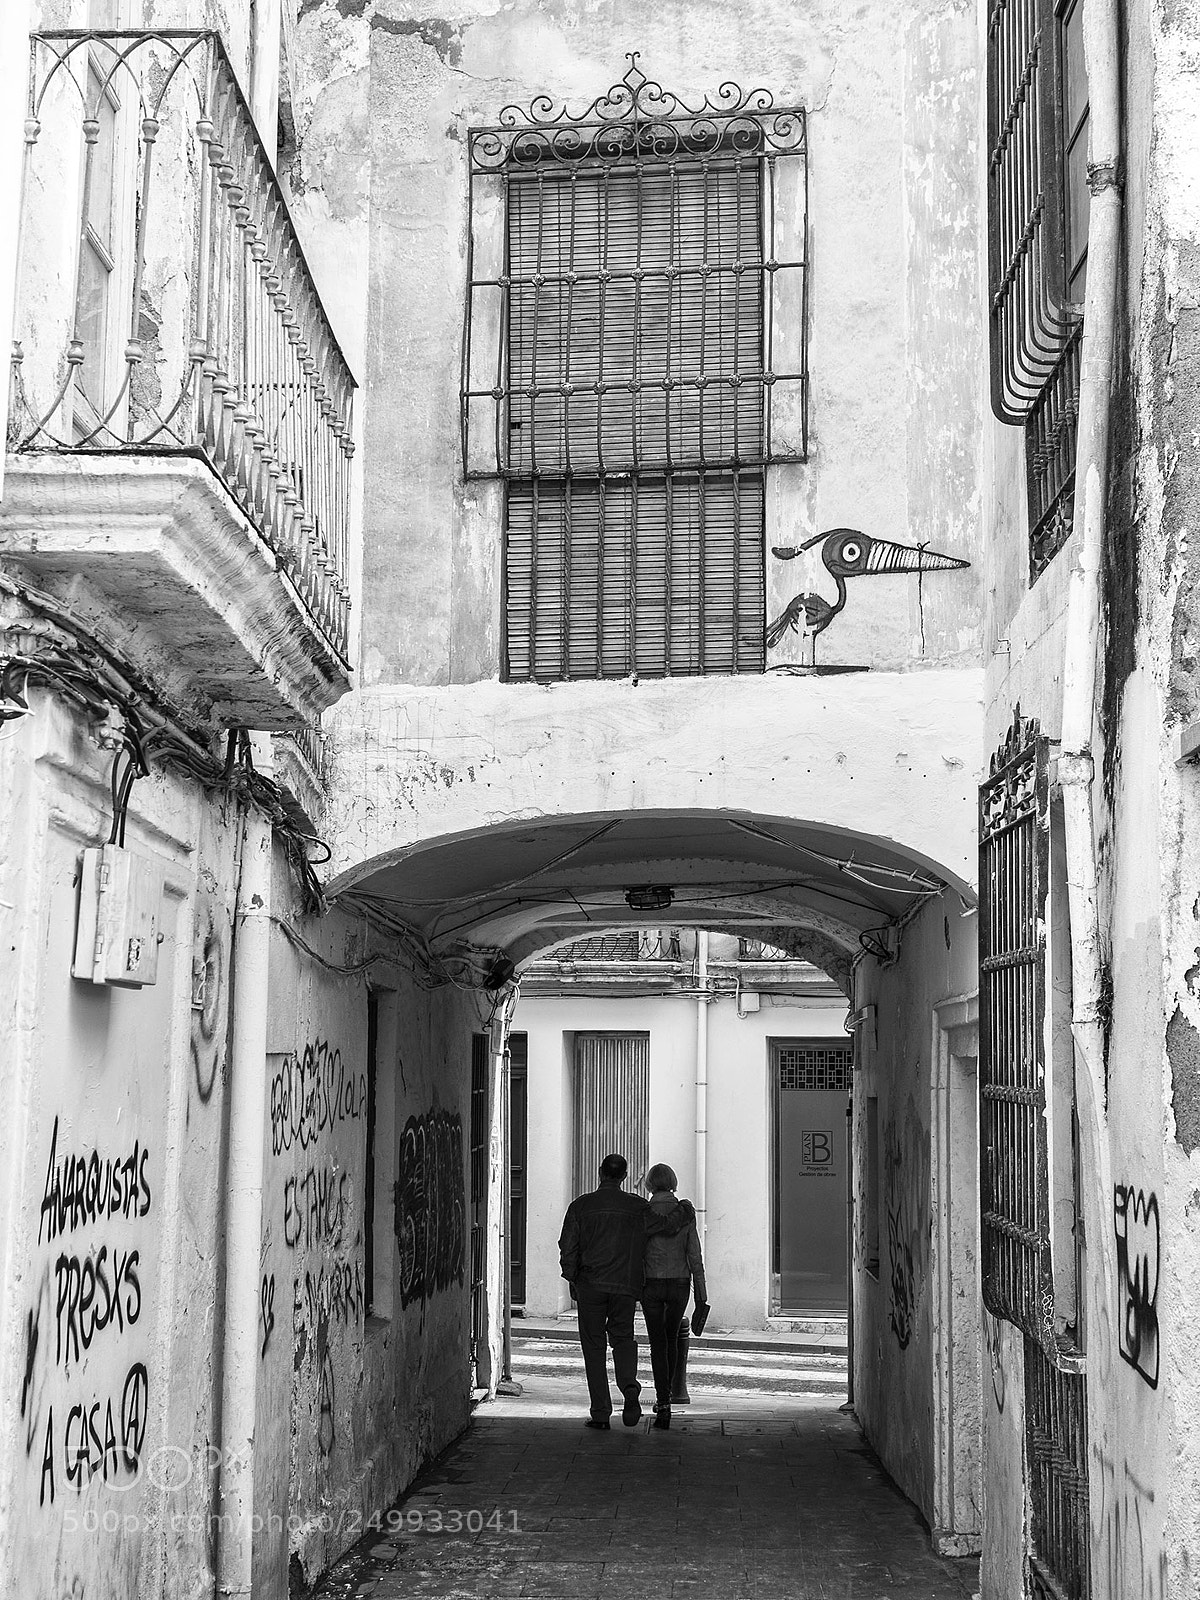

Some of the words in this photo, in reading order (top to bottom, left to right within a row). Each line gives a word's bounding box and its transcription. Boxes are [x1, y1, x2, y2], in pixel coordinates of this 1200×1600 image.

[38, 1114, 151, 1246] ANARQUISTAS
[812, 1133, 831, 1163] B
[40, 1405, 55, 1508] A
